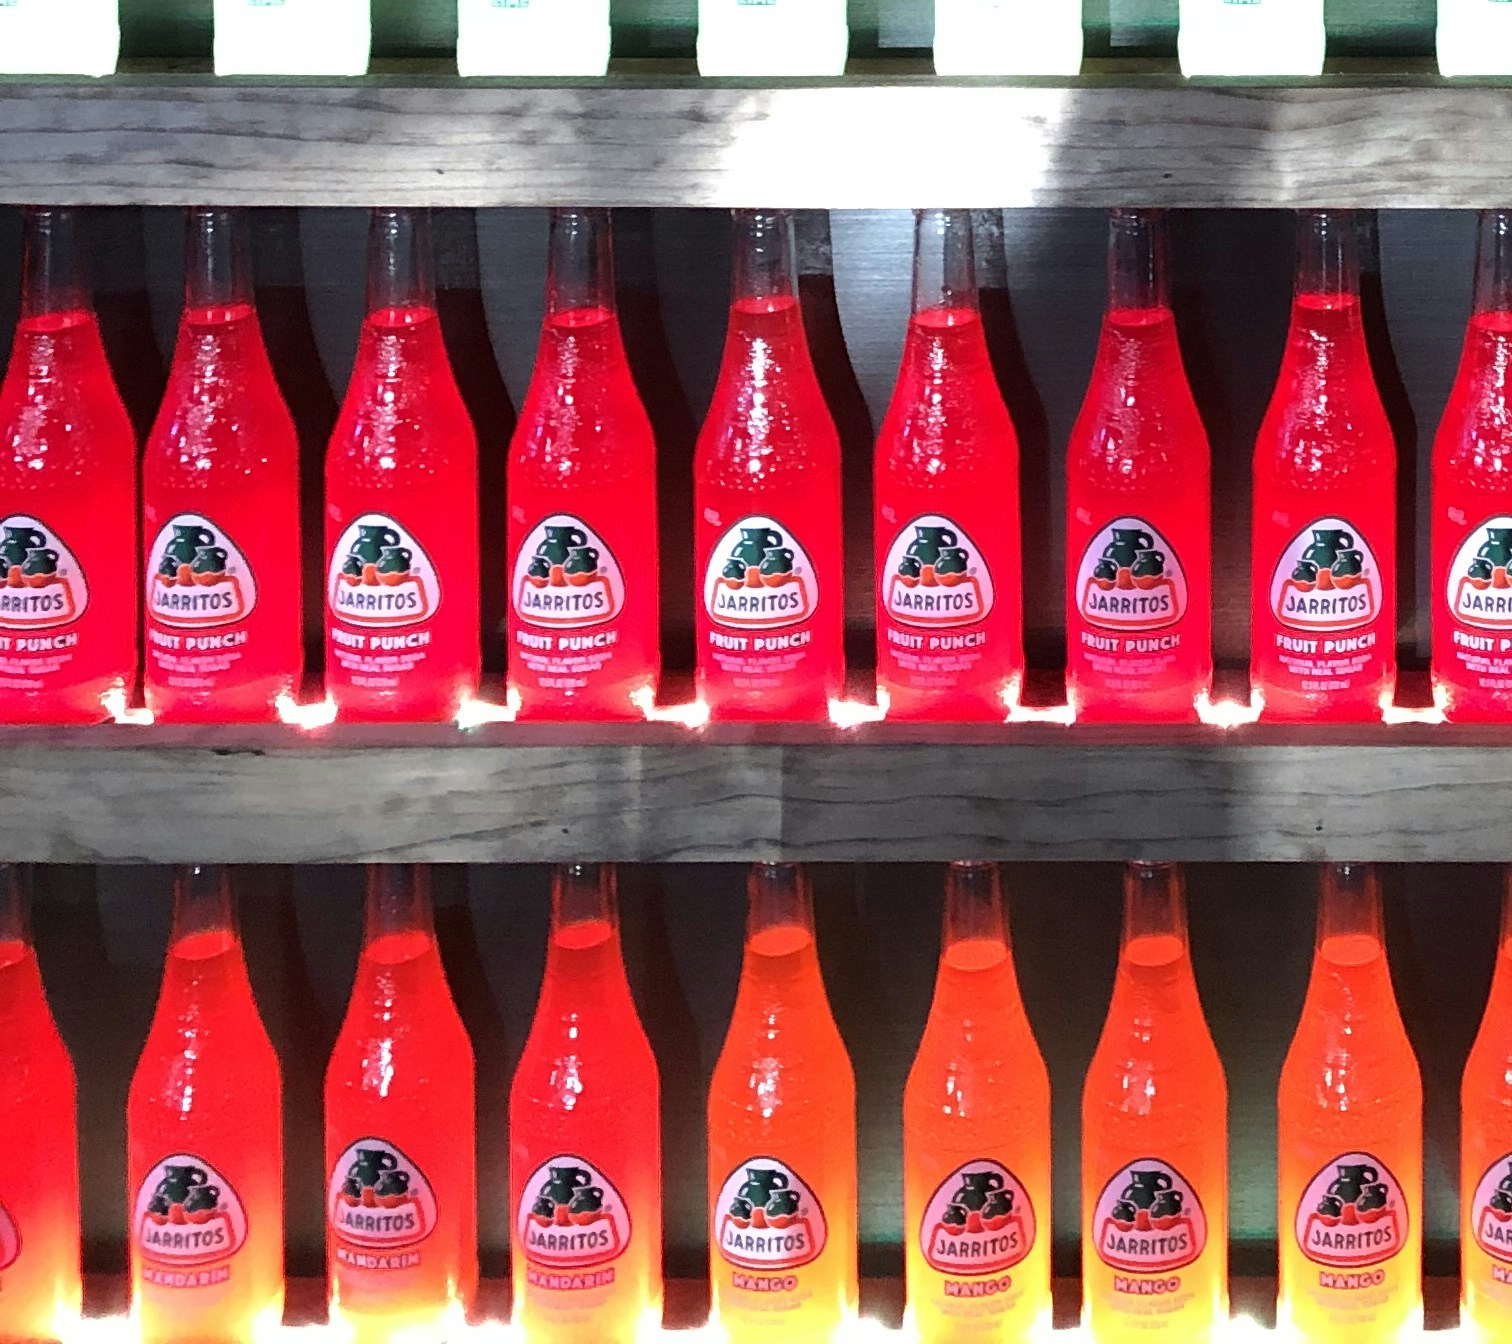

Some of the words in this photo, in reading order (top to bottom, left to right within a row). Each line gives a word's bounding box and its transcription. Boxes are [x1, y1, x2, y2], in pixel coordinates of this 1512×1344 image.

[524, 591, 604, 611] JARRITOS
[717, 591, 799, 611] JARRITOS
[894, 590, 974, 611] JARRITOS
[1088, 594, 1170, 614] JARRITOS
[1285, 593, 1367, 614] JARRITOS
[558, 630, 617, 651] PUNCH
[709, 631, 748, 650] FRUIT
[753, 630, 811, 651] PUNCH
[928, 630, 986, 650] PUNCH
[1081, 632, 1120, 652] FRUIT
[1125, 632, 1181, 653] PUNCH
[1276, 634, 1318, 653] FRUIT
[1322, 632, 1376, 654] PUNCH
[1453, 631, 1495, 651] FRUIT
[145, 1228, 225, 1249] JARRITOS
[528, 1229, 609, 1251] JARRITOS
[726, 1231, 806, 1253] JARRITOS
[936, 1233, 1019, 1257] JARRITOS
[1106, 1231, 1188, 1254] JARRITOS
[1311, 1227, 1392, 1249] JARRITOS
[526, 1268, 615, 1289] MANDARIN
[944, 1276, 1011, 1297] MANGO
[1113, 1275, 1181, 1295] MANGO
[1319, 1269, 1385, 1289] MANGO
